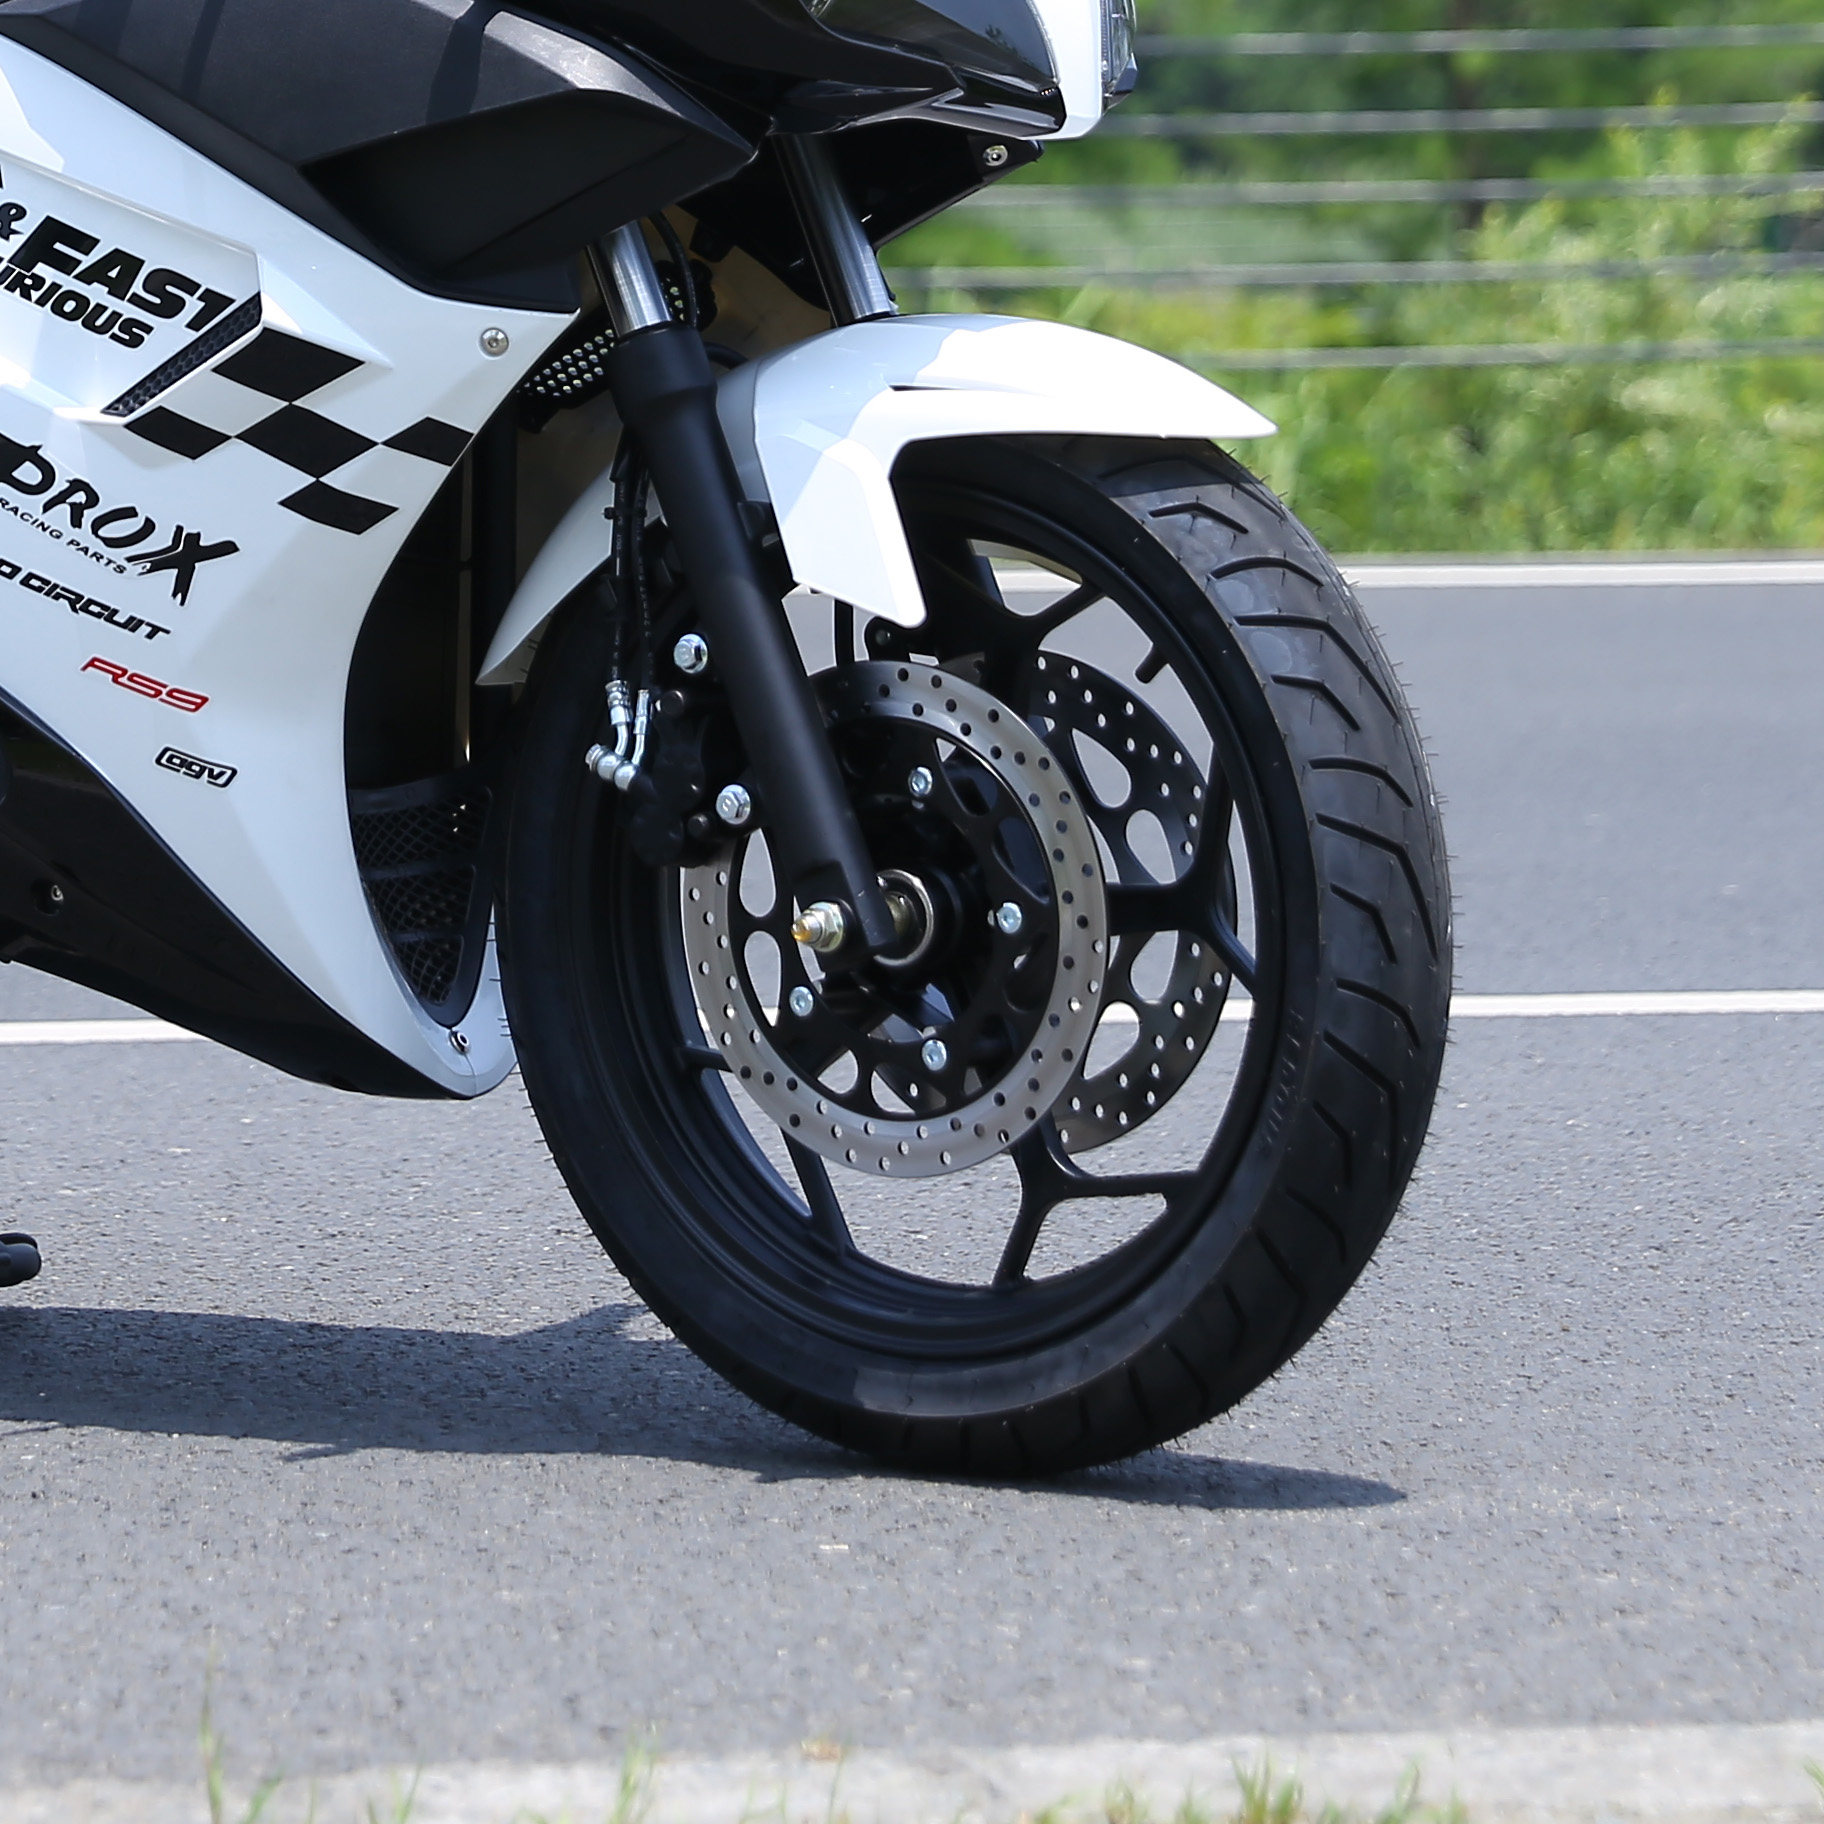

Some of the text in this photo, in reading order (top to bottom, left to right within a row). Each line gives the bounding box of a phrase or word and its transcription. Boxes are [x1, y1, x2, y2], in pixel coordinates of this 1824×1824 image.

[66, 538, 128, 575] PARTS
[18, 572, 172, 641] CIRCUIT
[80, 656, 210, 713] RS9
